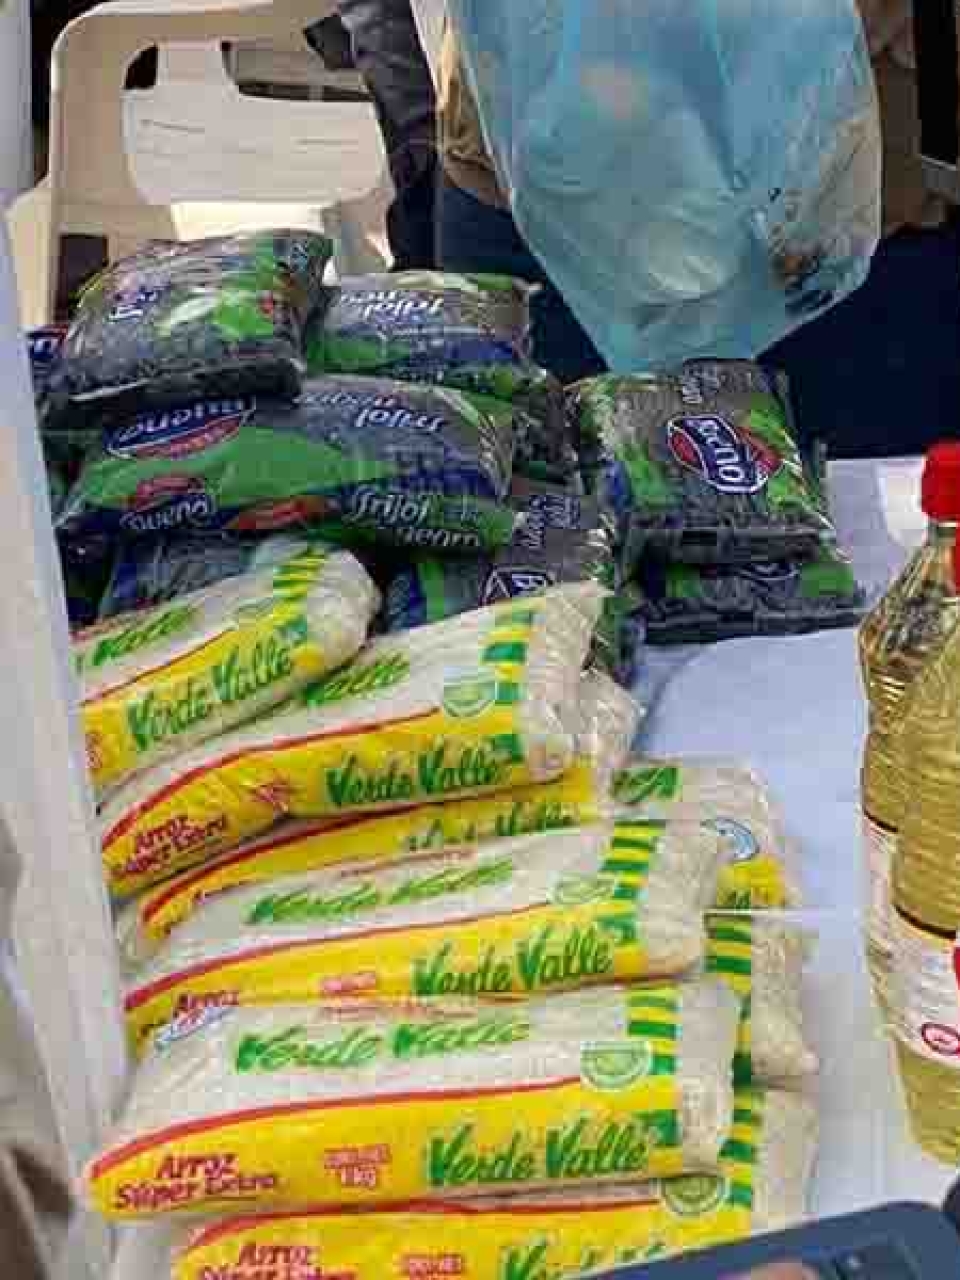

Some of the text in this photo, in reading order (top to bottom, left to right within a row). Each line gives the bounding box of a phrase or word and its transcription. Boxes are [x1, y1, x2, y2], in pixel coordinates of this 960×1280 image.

[210, 632, 296, 704] Valle
[326, 754, 414, 806] Verde
[418, 738, 503, 794] Valle
[247, 882, 378, 924] Verde
[411, 920, 613, 997] Verde Valle
[236, 1023, 529, 1073] Verde Valle
[157, 1154, 238, 1180] Arroz
[427, 1113, 649, 1187] Verde Valle
[238, 1245, 313, 1266] Arroz
